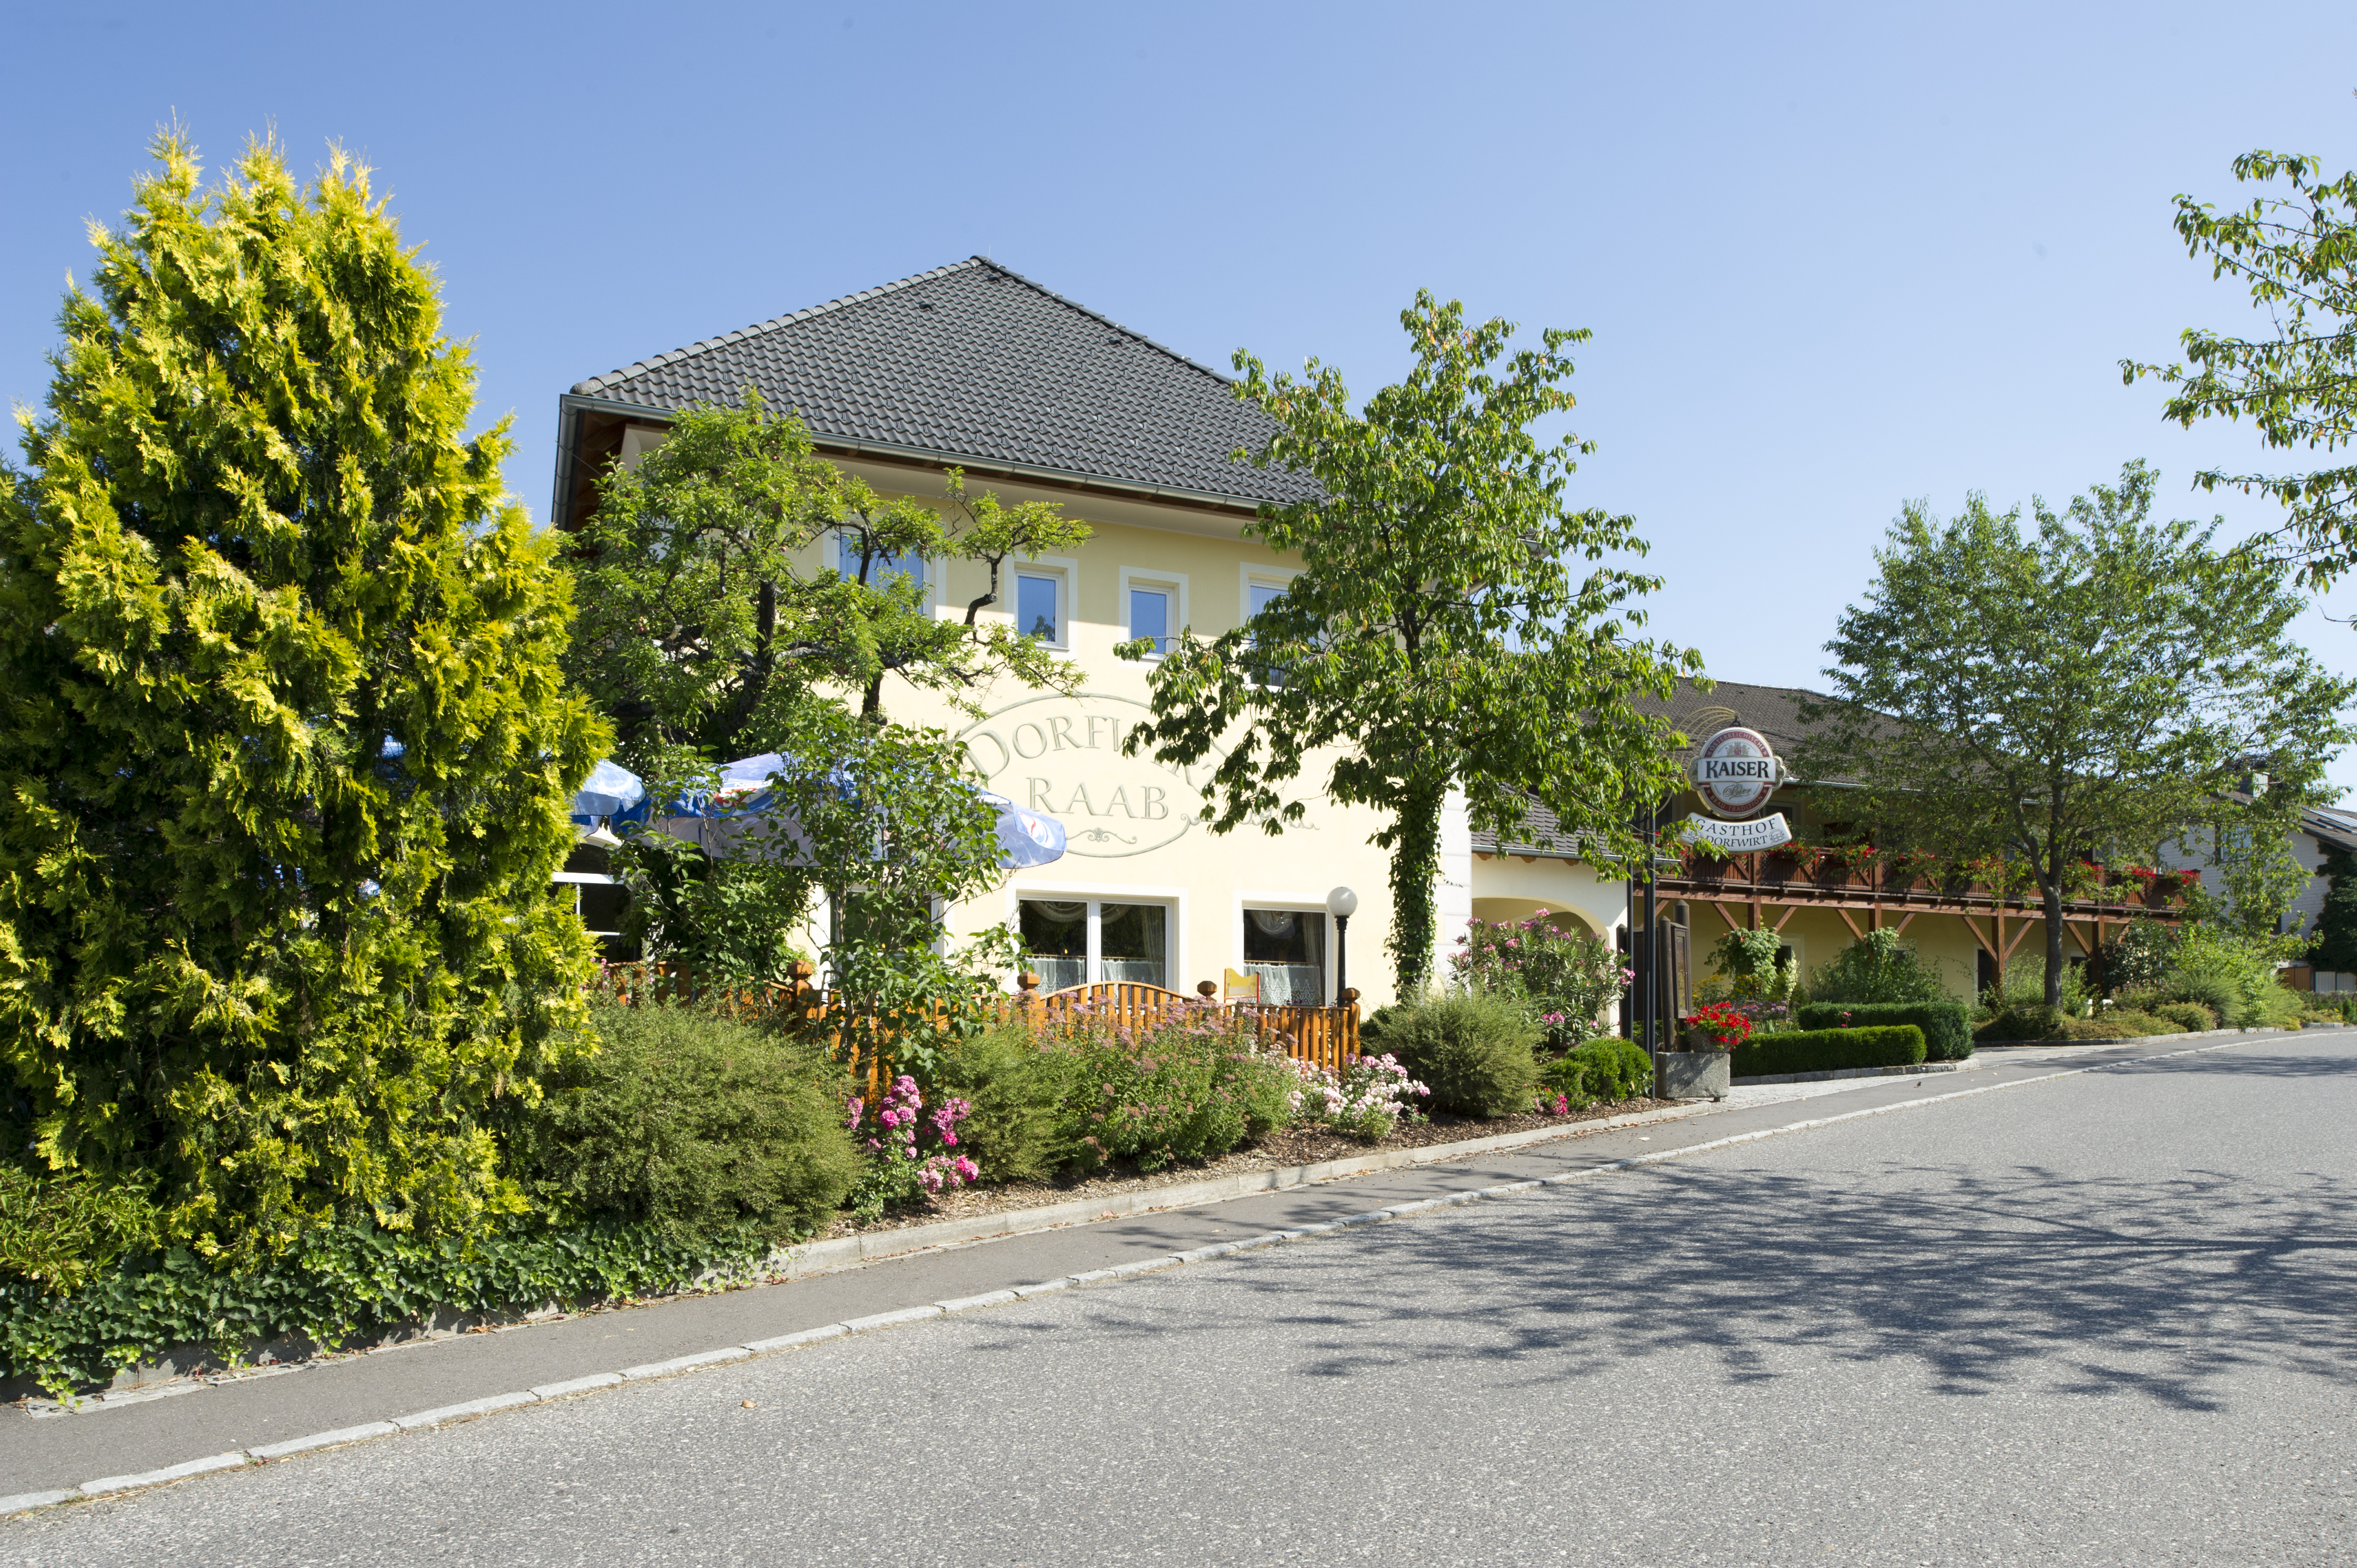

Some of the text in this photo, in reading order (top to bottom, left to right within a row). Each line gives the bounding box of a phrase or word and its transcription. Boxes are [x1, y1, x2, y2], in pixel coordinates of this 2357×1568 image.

[1705, 760, 1770, 778] KAISER
[1026, 776, 1169, 819] RAAB
[1722, 784, 1752, 800] Bier
[1695, 818, 1776, 837] GASTHOF
[1706, 834, 1768, 847] DORFWIRT
